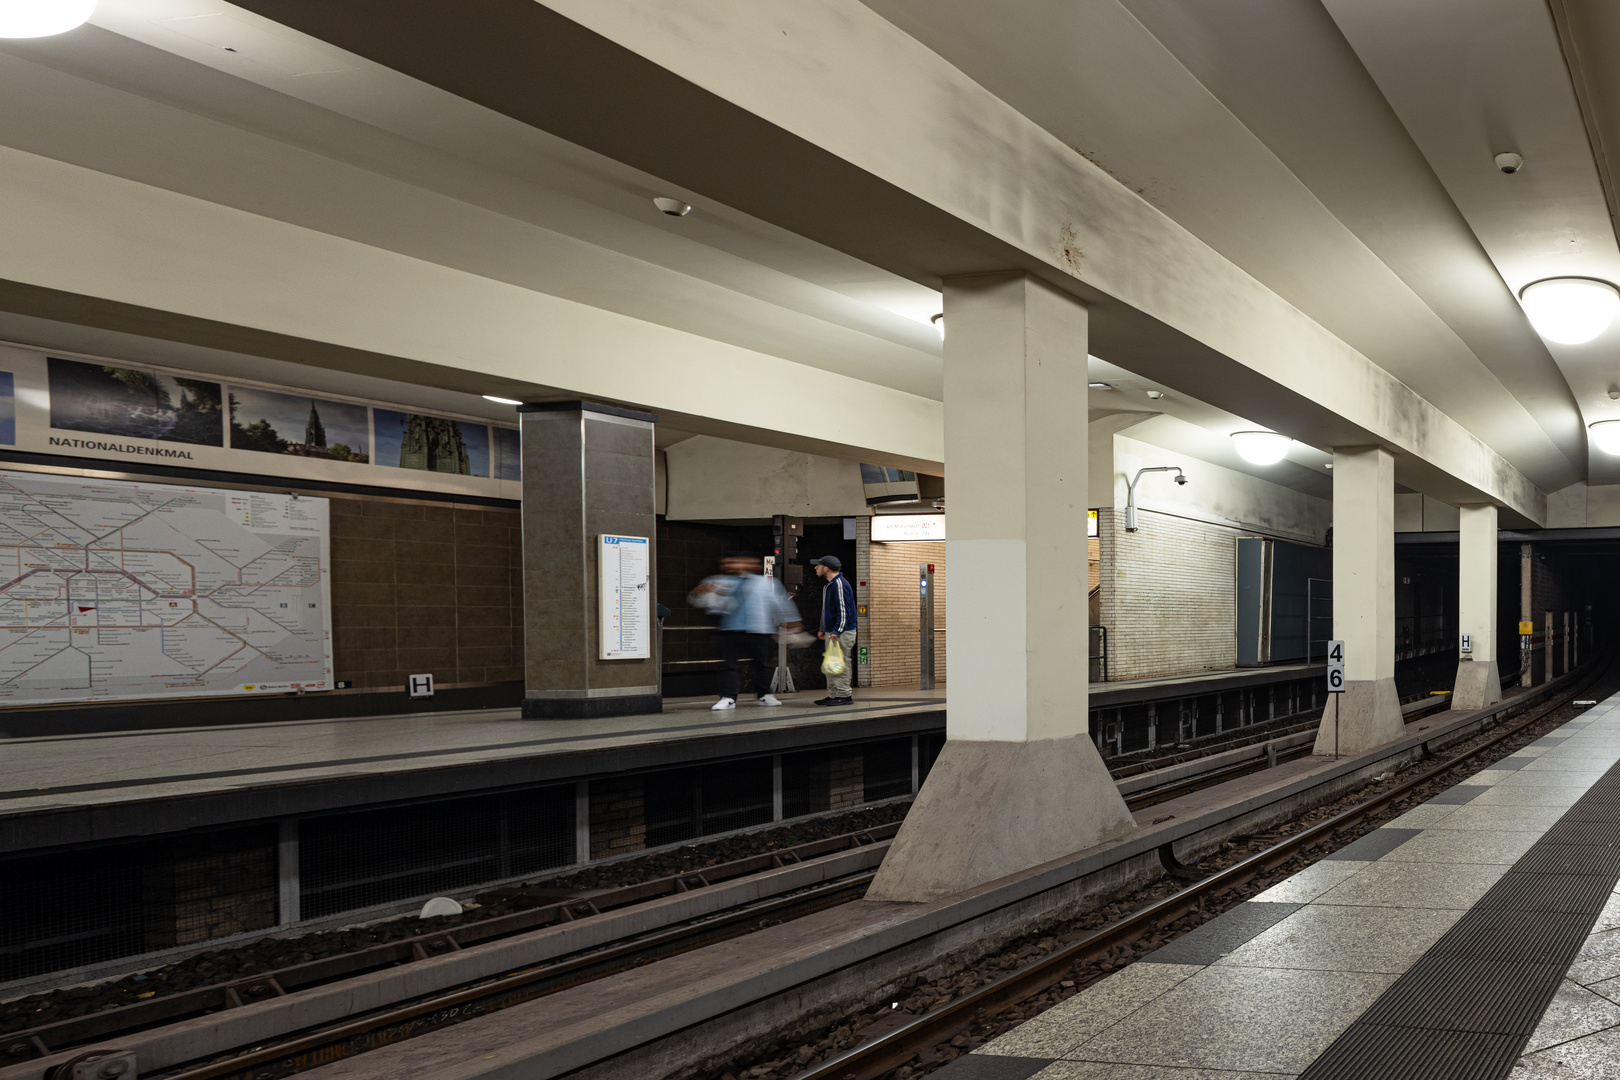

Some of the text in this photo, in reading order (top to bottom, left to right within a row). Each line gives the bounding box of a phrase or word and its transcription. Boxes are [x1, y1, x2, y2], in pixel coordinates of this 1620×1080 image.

[49, 437, 194, 459] NATIONALDENKMAL
[1462, 635, 1469, 647] H
[1330, 644, 1342, 662] 4
[412, 677, 431, 693] H
[1330, 669, 1342, 687] 6
